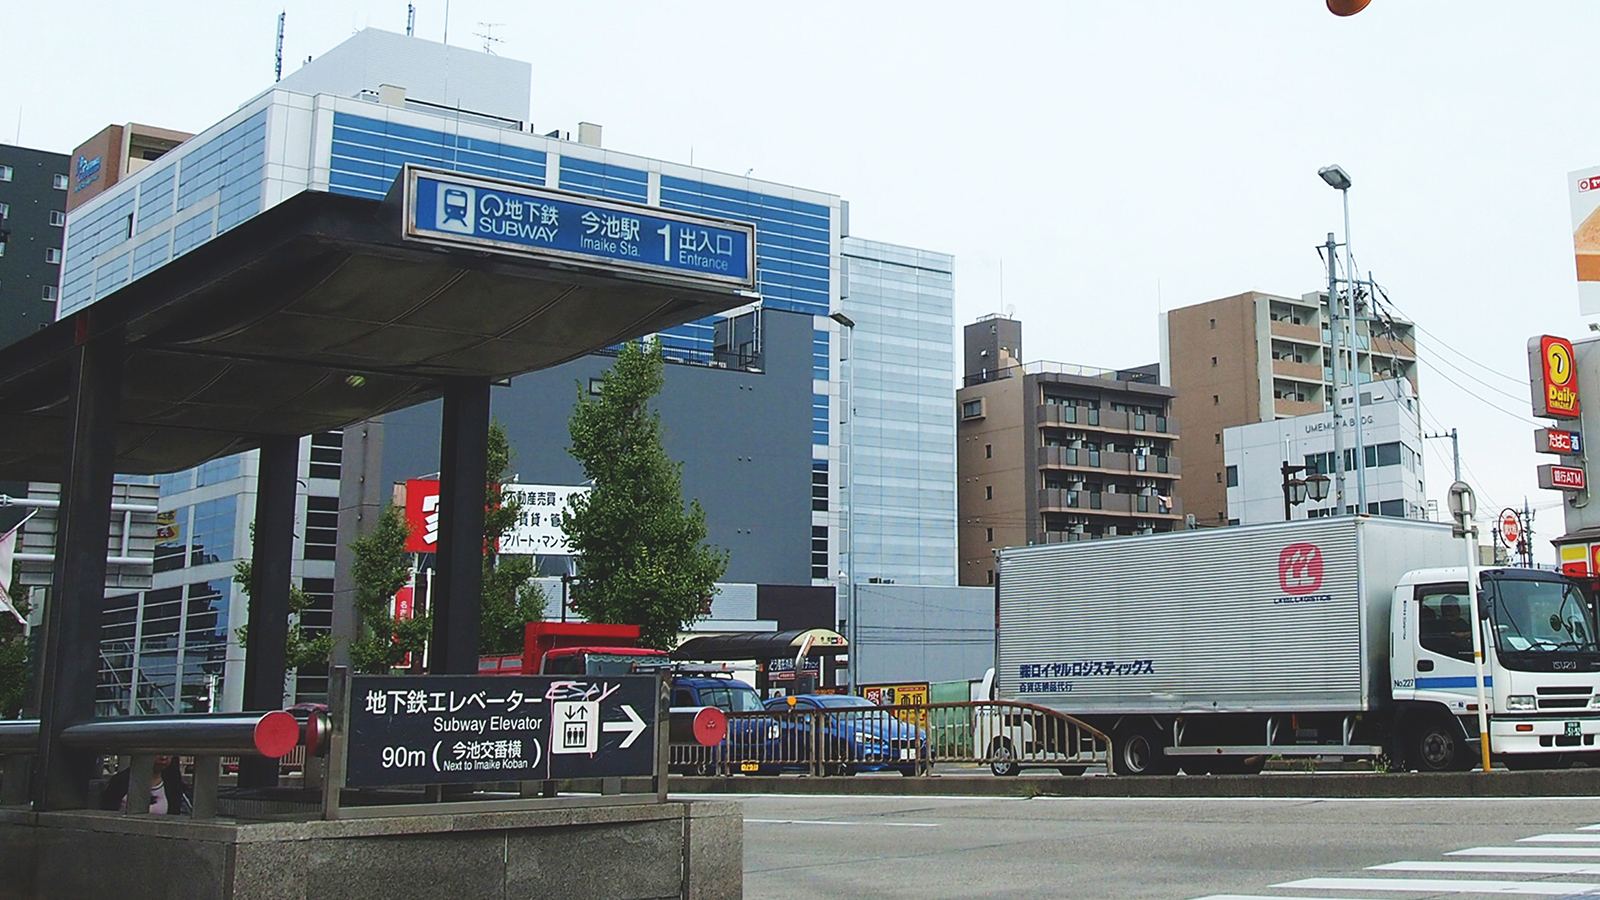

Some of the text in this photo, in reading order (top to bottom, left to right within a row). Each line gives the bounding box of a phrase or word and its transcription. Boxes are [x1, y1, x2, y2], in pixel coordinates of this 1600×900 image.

[504, 198, 733, 262] 地下鉄 今池駅 1 出入口
[479, 216, 728, 271] SUBWAY Imaike Sta. Entrance
[1549, 384, 1576, 410] Daily
[1305, 415, 1374, 434] UMEMUA BDG.
[1549, 433, 1570, 449] たばこ
[1552, 661, 1577, 670] ISUZU
[365, 689, 543, 715] 地下鉄エレベーター
[433, 715, 543, 735] Subway Elevator
[381, 746, 426, 769] 90m
[443, 759, 528, 771] Next to Imaike Koban
